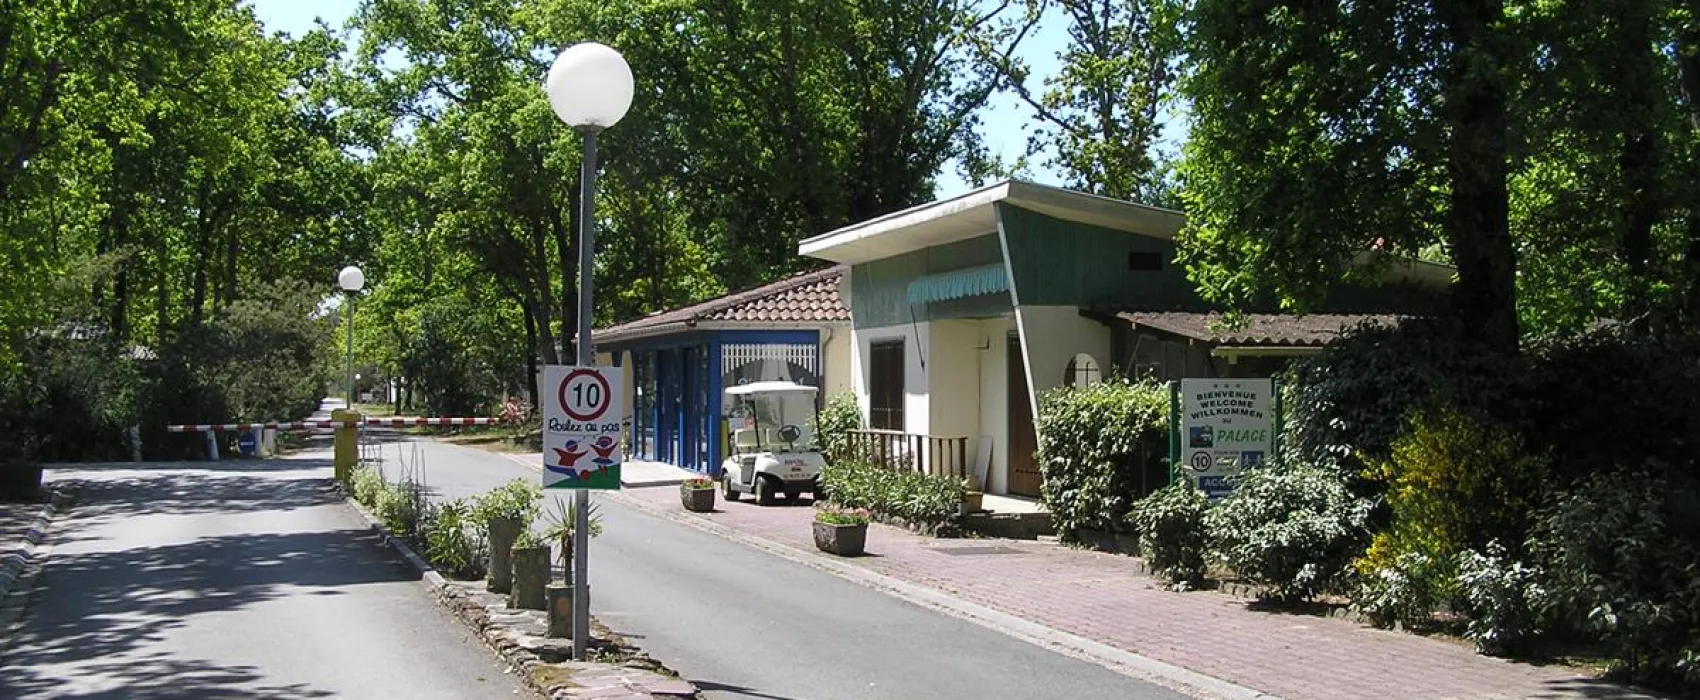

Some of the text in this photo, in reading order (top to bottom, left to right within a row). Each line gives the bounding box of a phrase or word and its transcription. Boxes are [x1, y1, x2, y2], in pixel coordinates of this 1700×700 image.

[573, 383, 600, 408] 10
[1196, 391, 1257, 401] BIENVENUE
[1200, 400, 1254, 409] WELCOME
[1190, 408, 1264, 420] WILLKOMMEN
[548, 418, 620, 433] Roulez au pas
[1216, 429, 1267, 443] PALACE
[1195, 456, 1209, 468] 10
